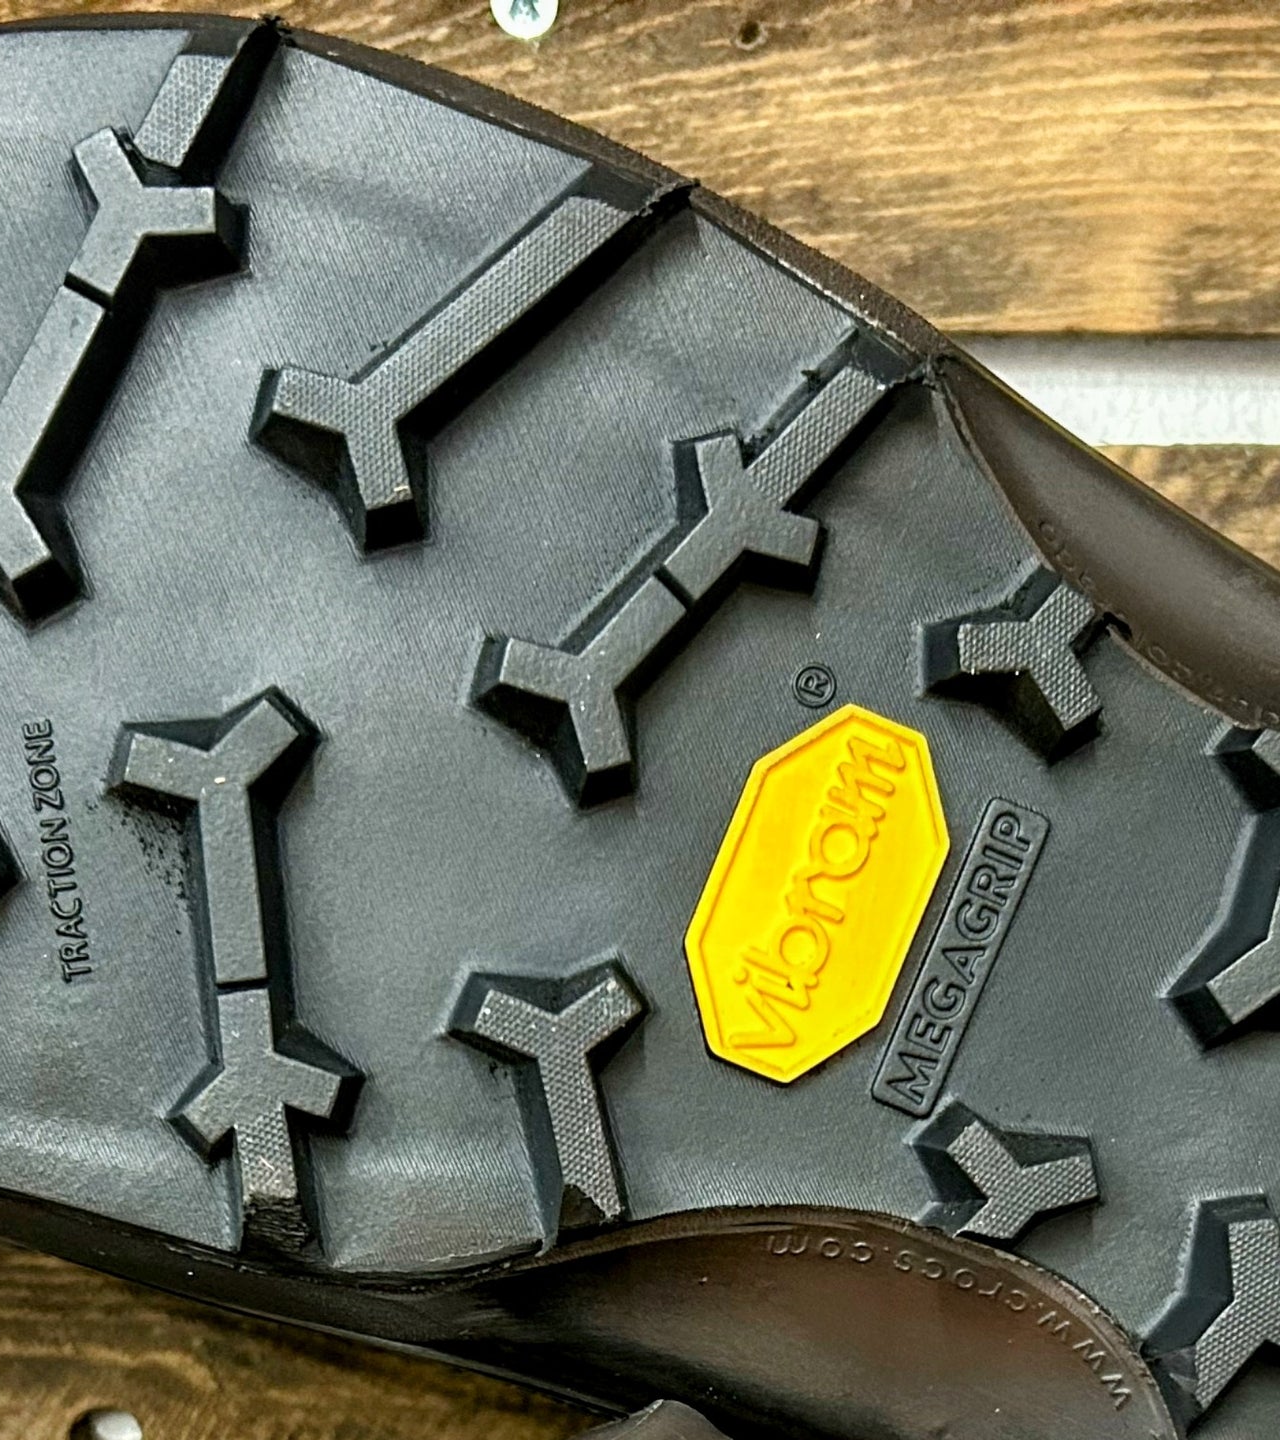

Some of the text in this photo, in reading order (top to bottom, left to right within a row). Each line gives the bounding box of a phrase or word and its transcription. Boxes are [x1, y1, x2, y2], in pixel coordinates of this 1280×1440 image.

[22, 718, 93, 983] TRACTION ZONE
[885, 810, 1032, 1106] MEGAGRIP
[766, 1235, 1132, 1411] www.crocs.com
